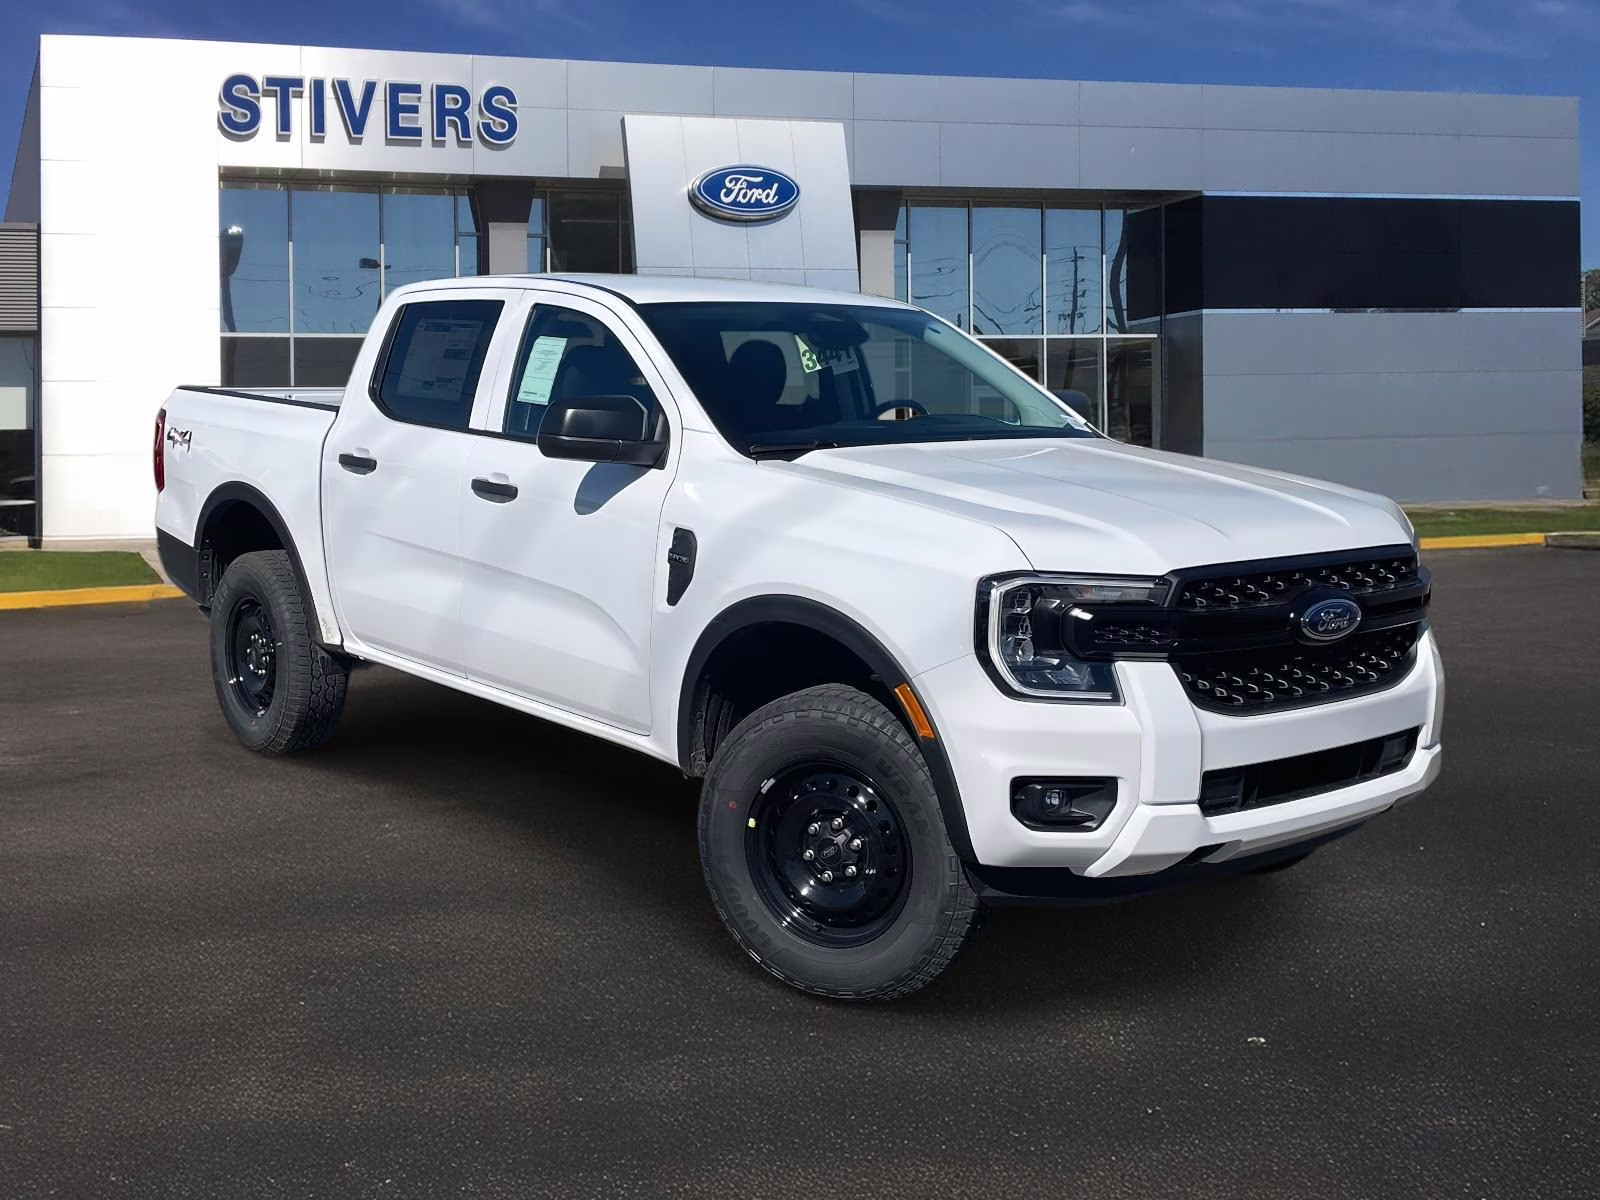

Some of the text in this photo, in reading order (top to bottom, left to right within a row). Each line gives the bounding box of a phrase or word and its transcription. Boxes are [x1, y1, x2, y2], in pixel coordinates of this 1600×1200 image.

[217, 72, 519, 148] STIVERS
[720, 174, 778, 204] Ford
[1318, 608, 1350, 632] Ford
